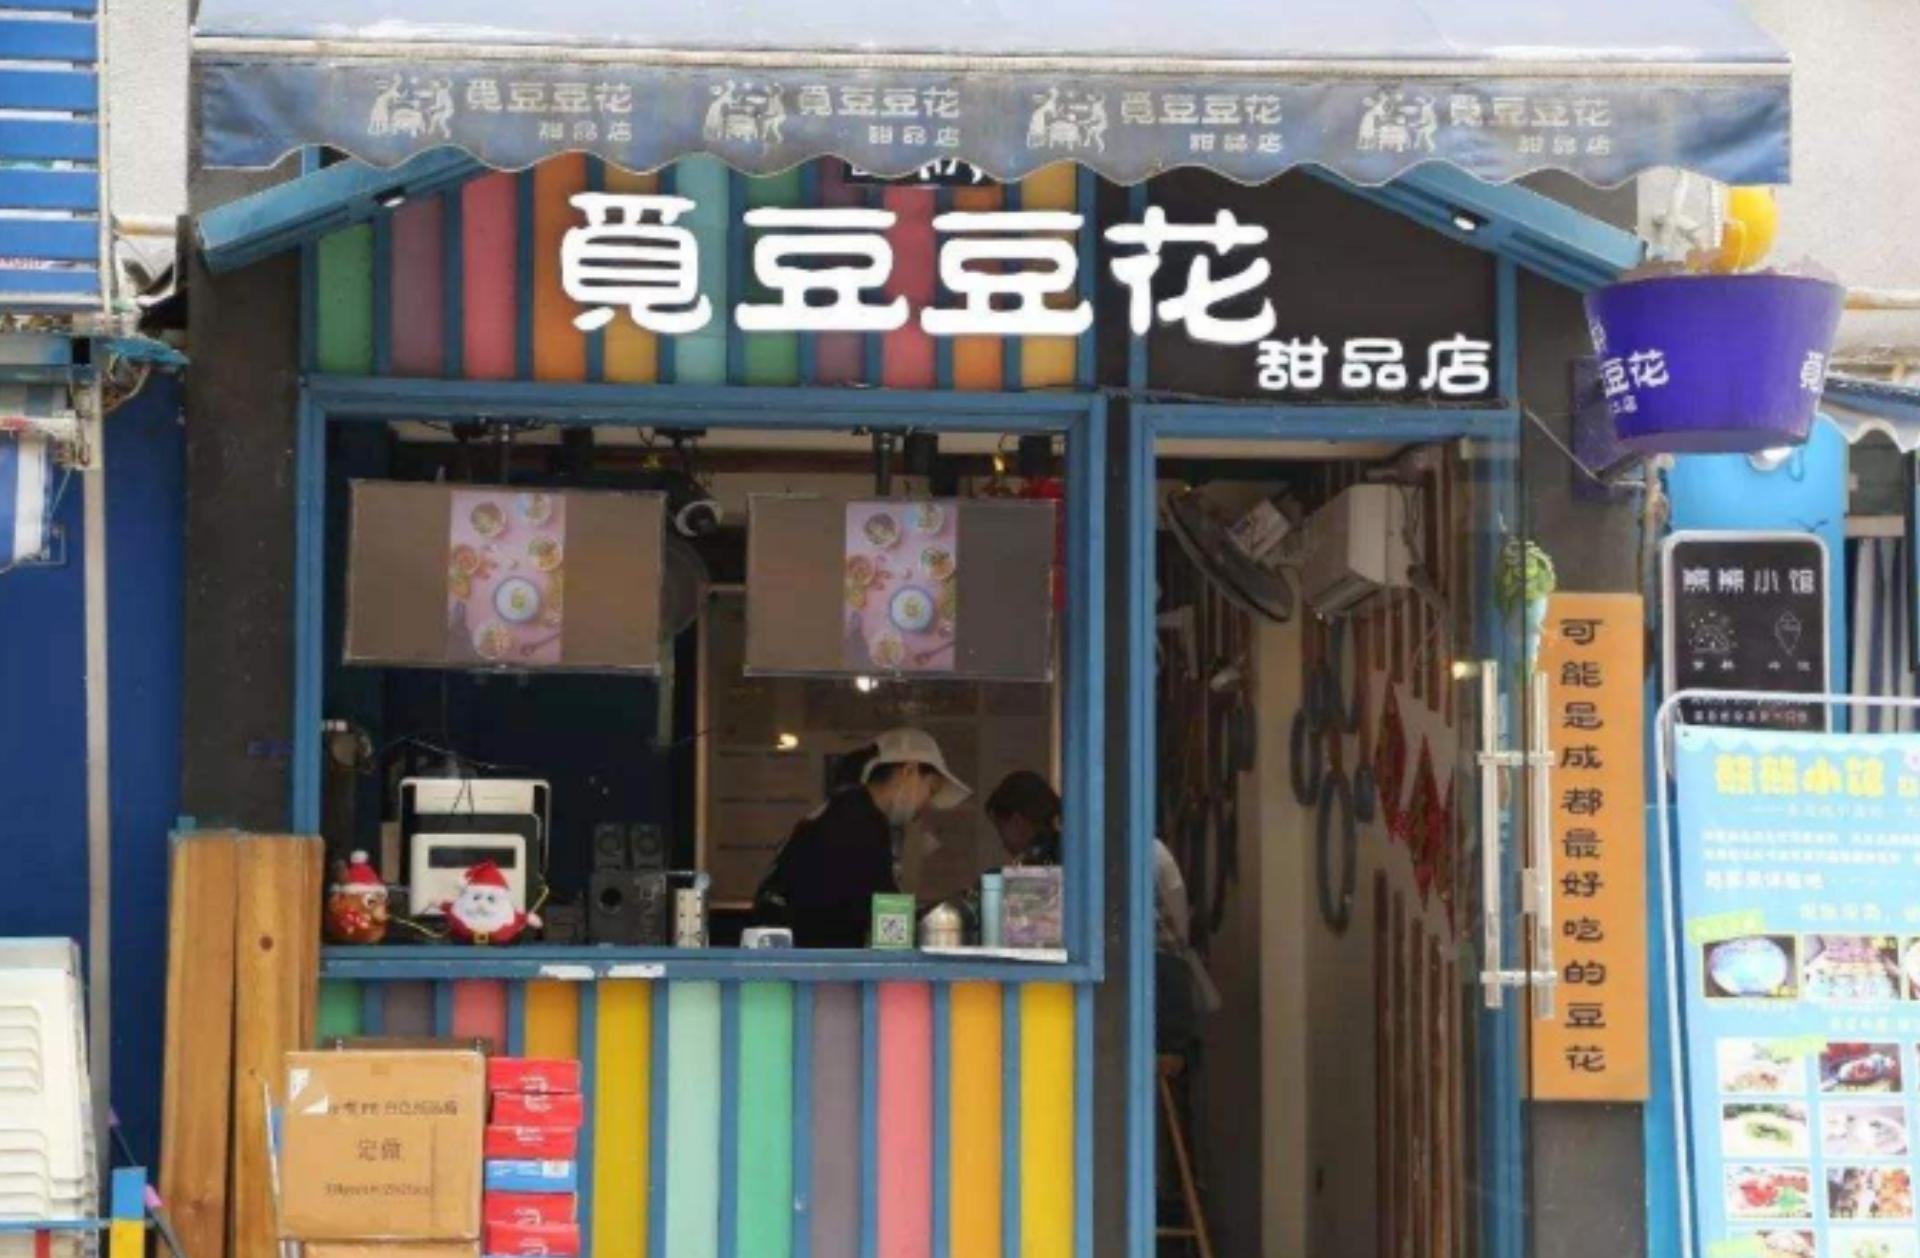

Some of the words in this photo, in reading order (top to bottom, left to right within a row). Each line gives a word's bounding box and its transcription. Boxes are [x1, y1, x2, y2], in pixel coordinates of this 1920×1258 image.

[1256, 334, 1492, 395] 甜品店
[1558, 618, 1607, 1073] 可能是成都最好吃的豆花
